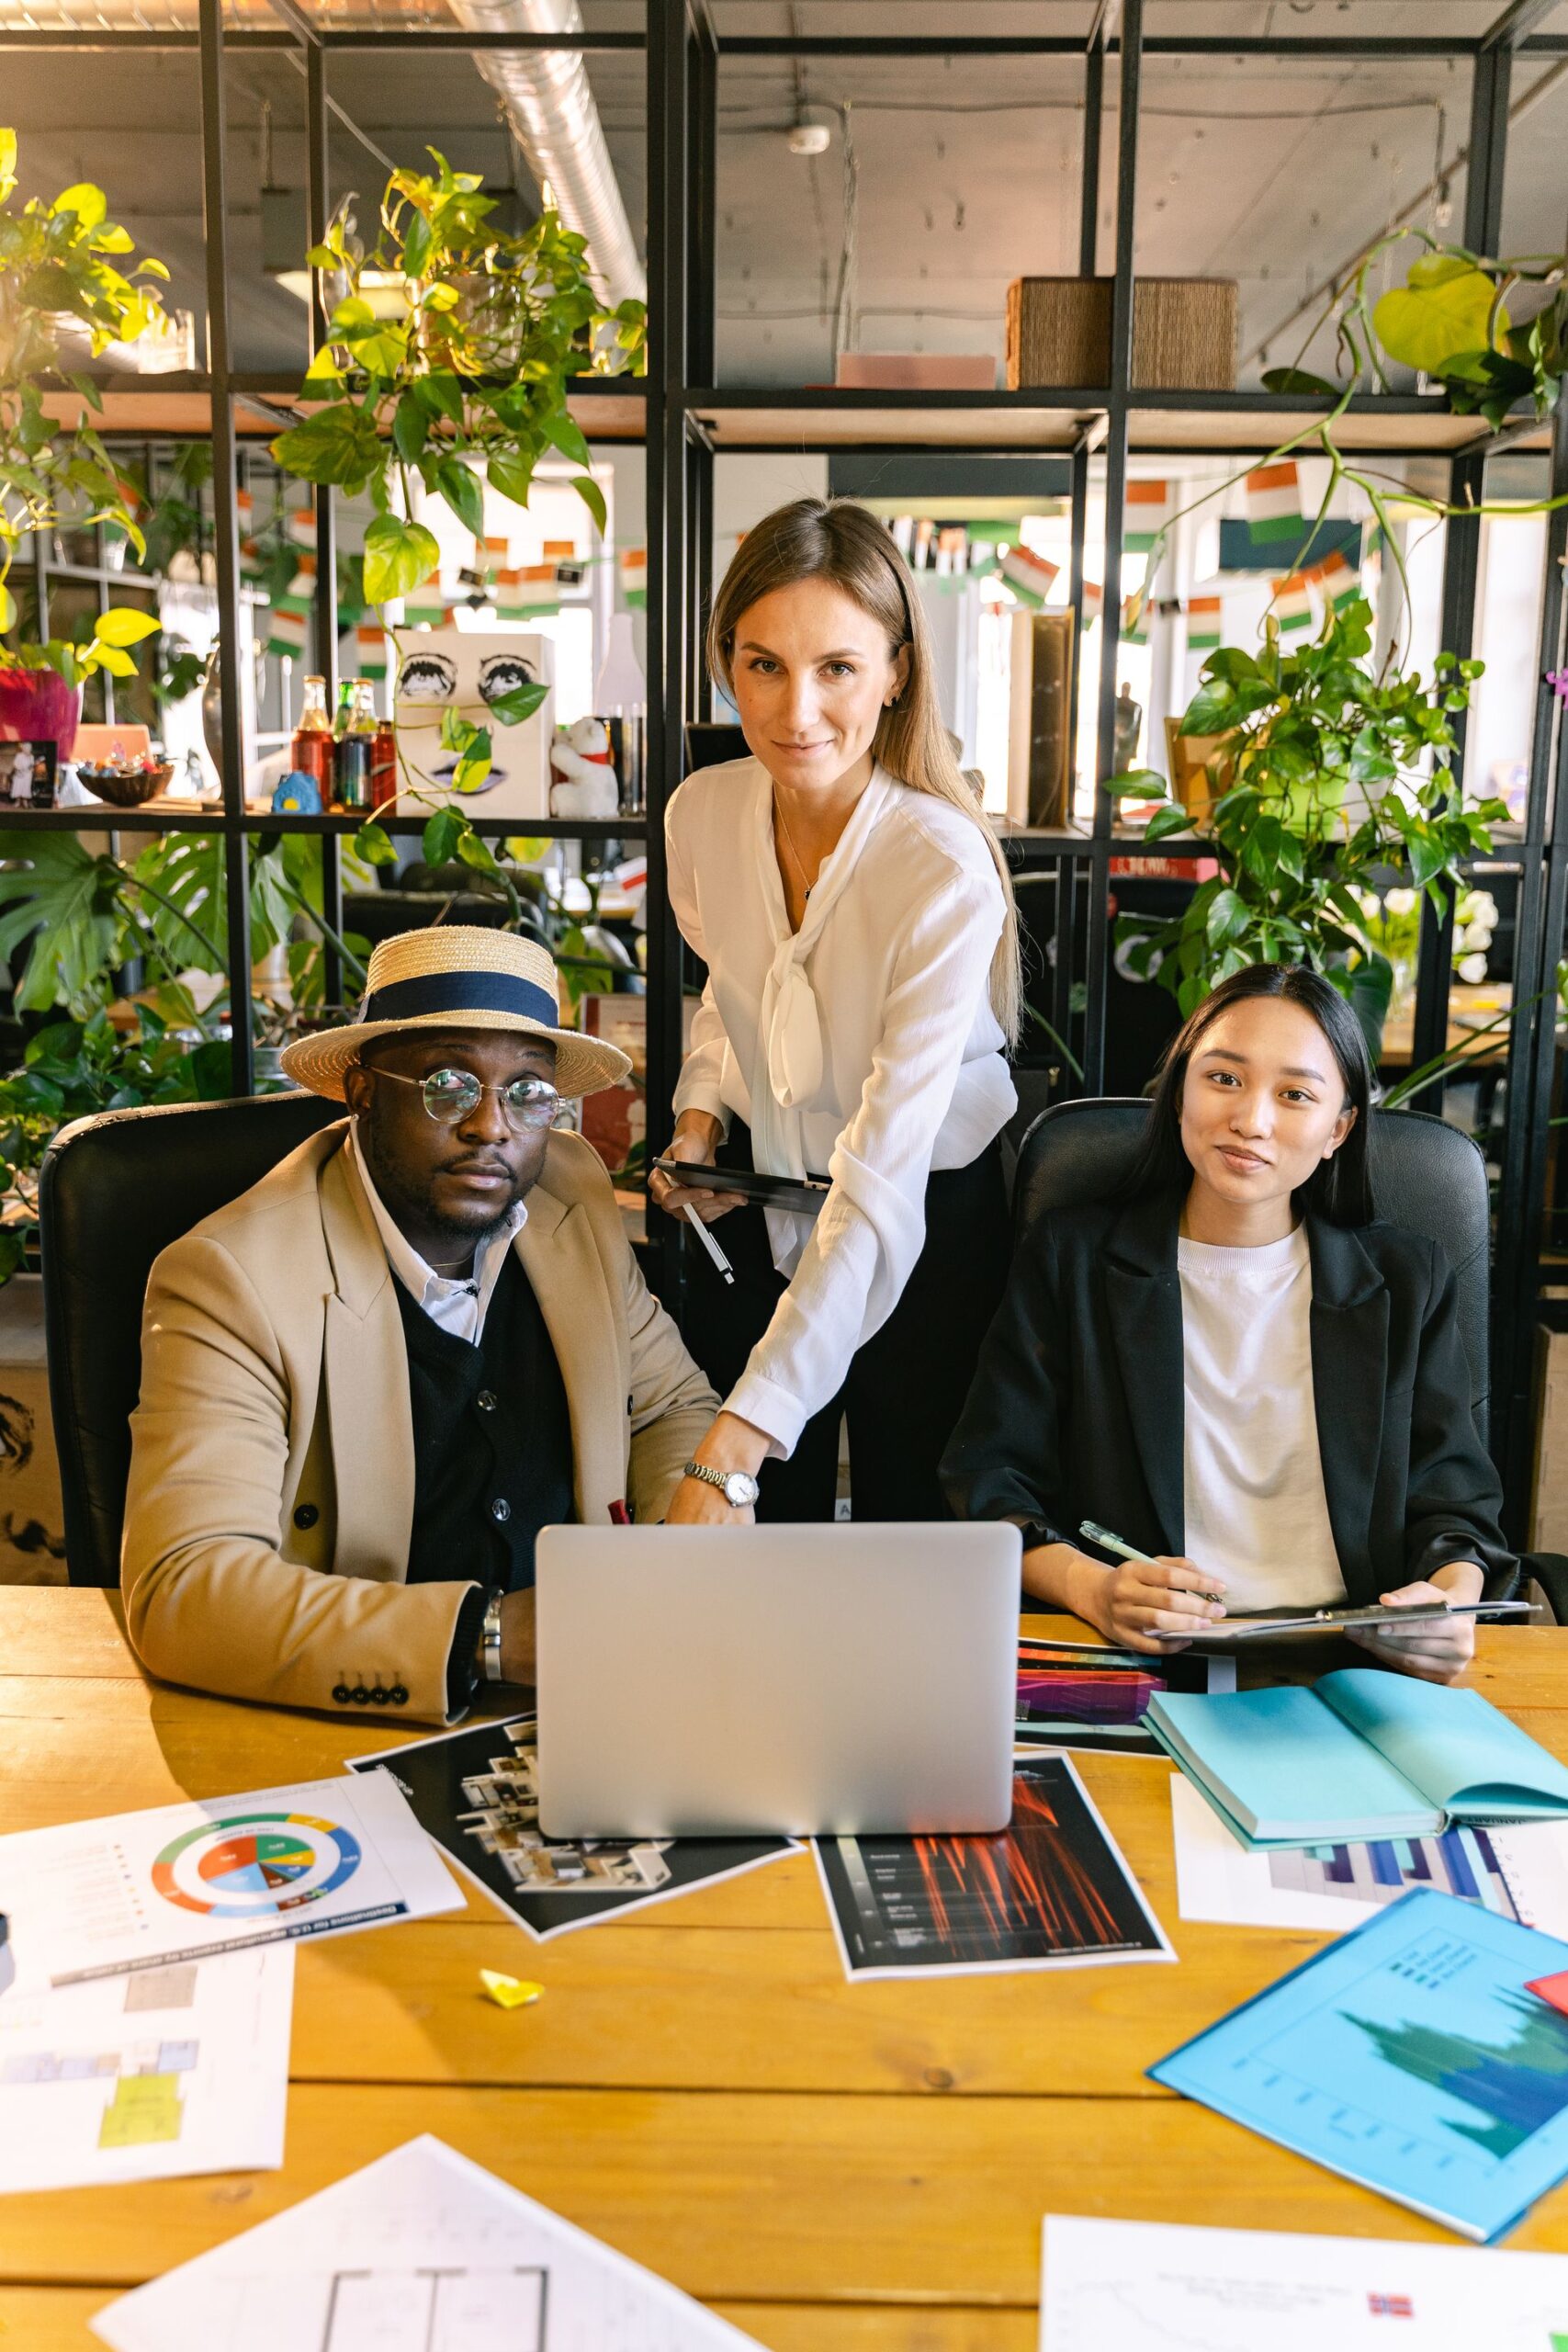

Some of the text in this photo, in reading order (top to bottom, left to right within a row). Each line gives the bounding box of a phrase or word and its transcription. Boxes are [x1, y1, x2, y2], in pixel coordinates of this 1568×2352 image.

[1468, 1816, 1527, 1825] JANUARY
[331, 1905, 396, 1926] Destinations
[313, 1917, 329, 1930] for
[225, 1929, 287, 1949] agricultural
[165, 1951, 180, 1962] by
[181, 1942, 223, 1959] exports
